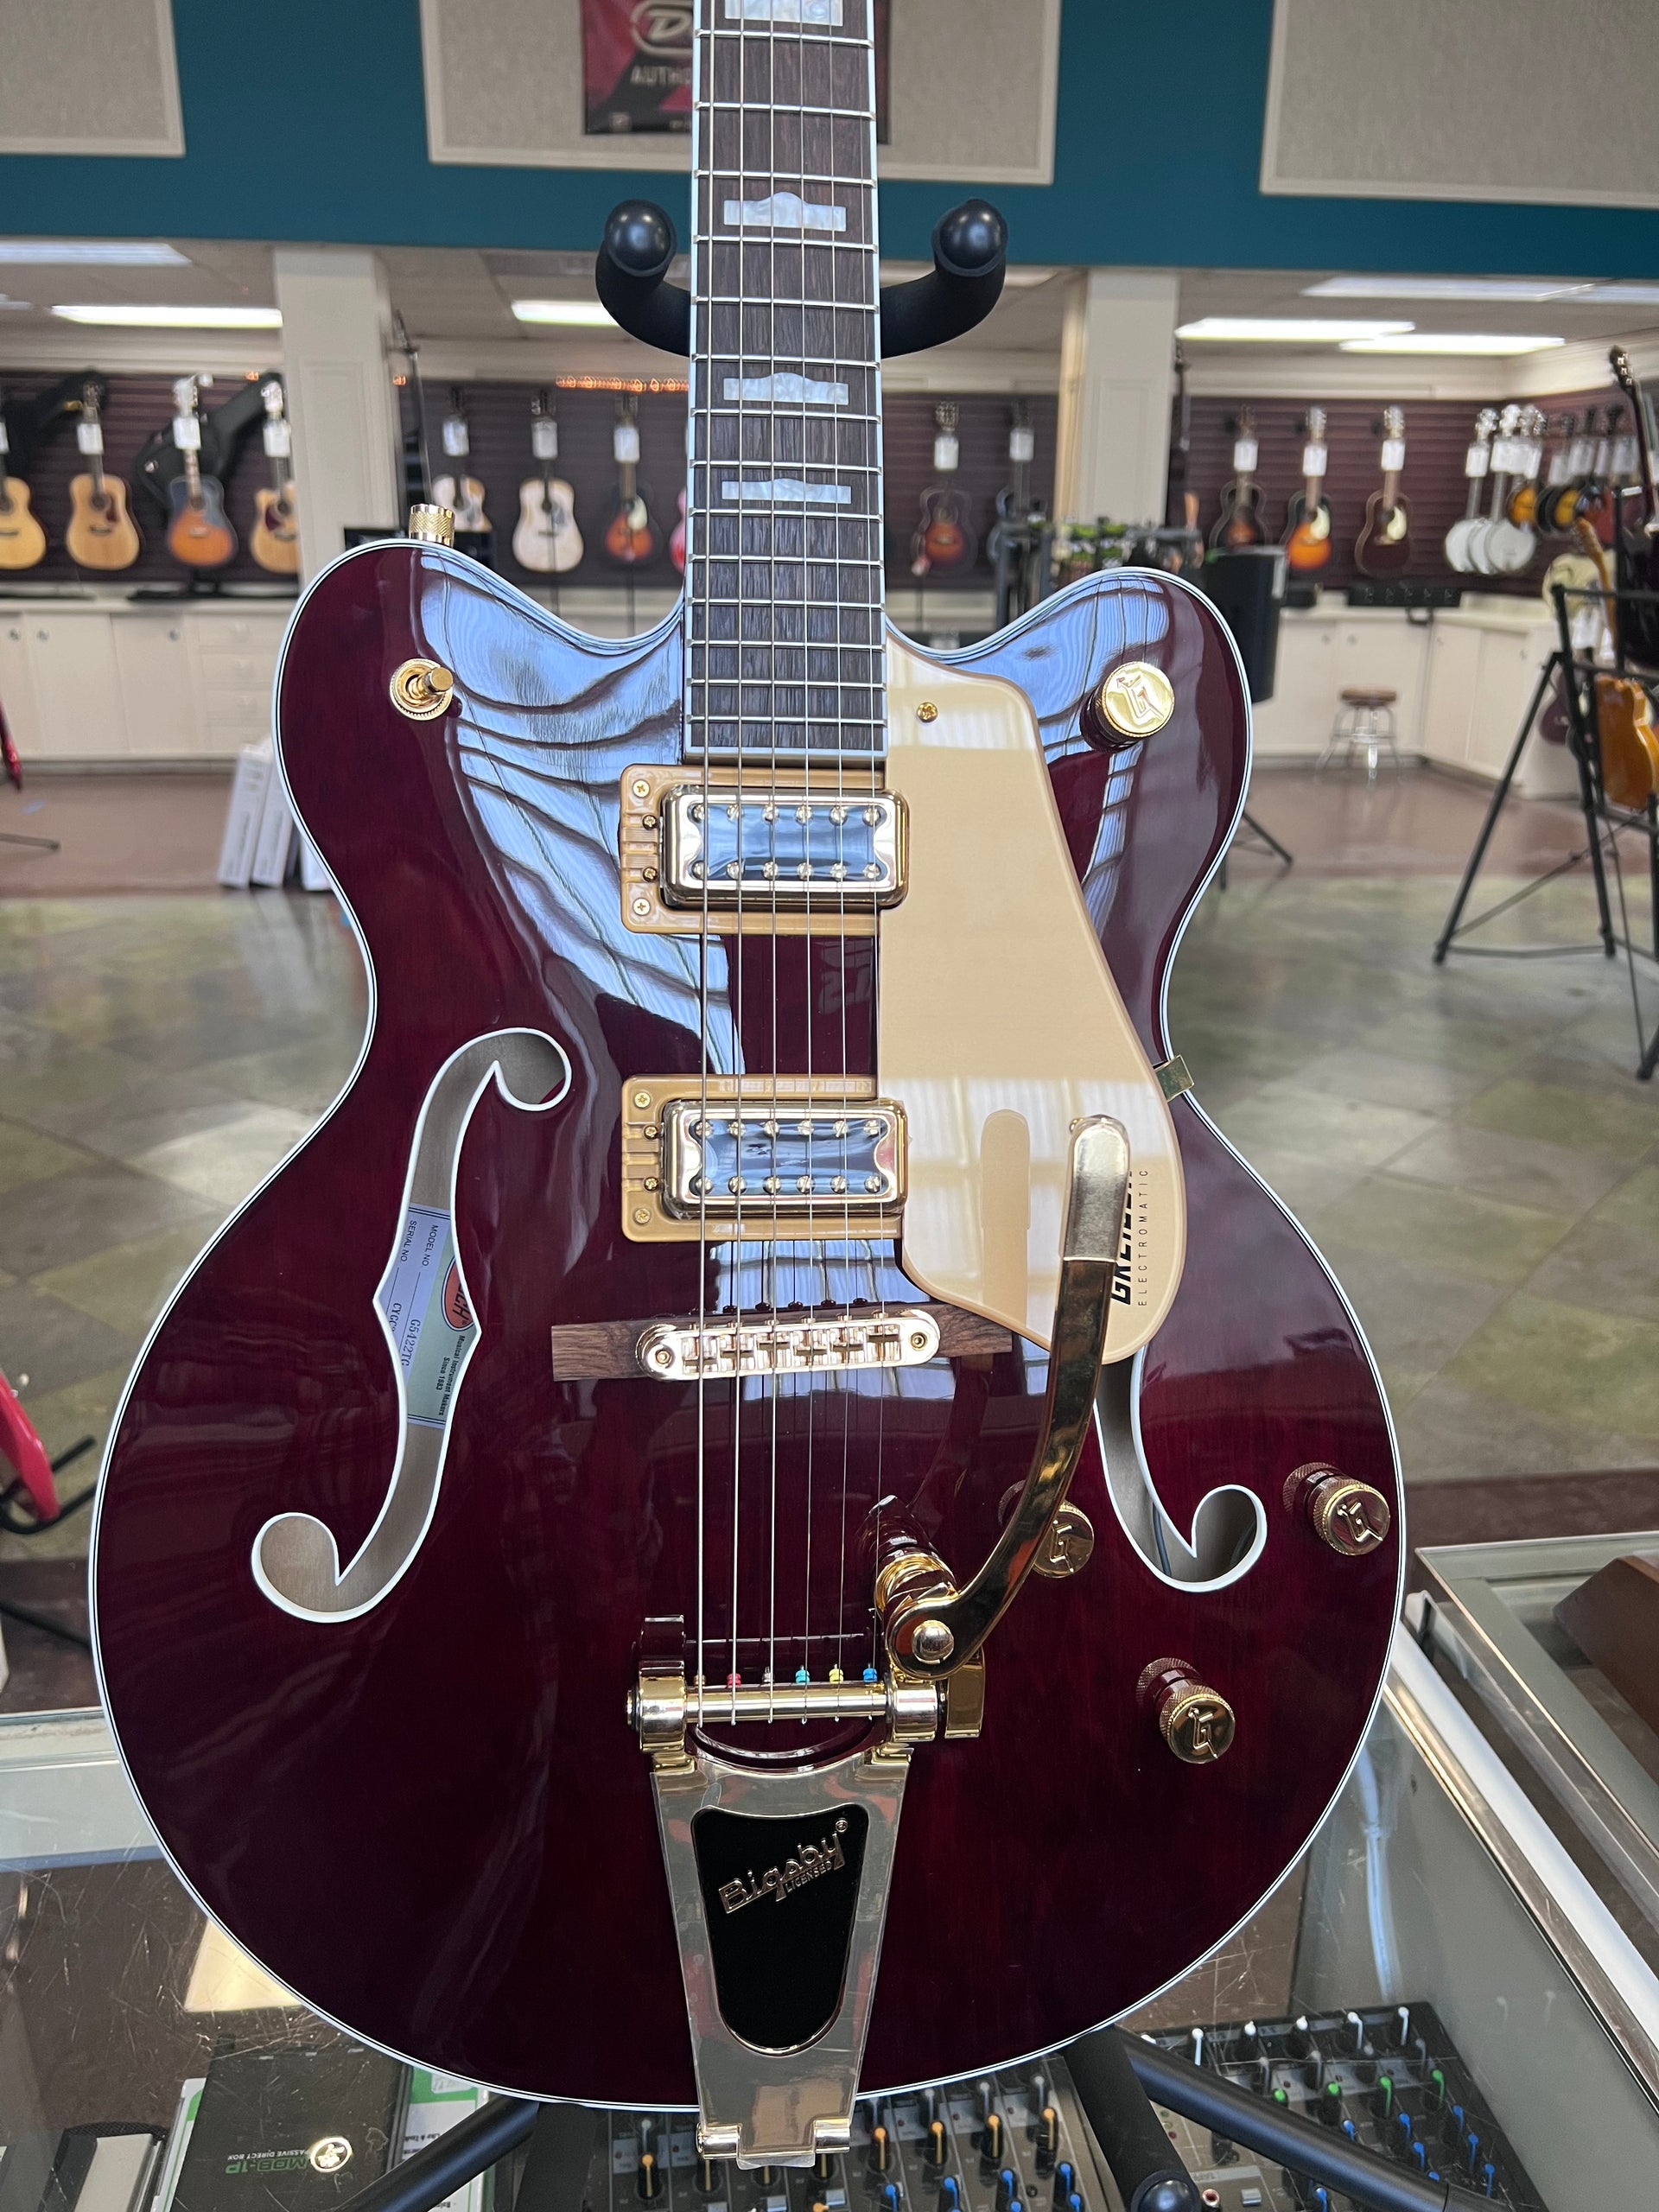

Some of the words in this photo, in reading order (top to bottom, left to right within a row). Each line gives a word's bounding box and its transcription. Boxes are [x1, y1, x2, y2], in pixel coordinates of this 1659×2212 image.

[404, 1220, 416, 1248] SERIAL
[424, 1224, 439, 1253] MODEL
[1138, 1170, 1148, 1306] ELECTROMATIC
[401, 1319, 422, 1367] G5422TG
[454, 1334, 466, 1359] Musical
[440, 1357, 450, 1374] Since
[445, 1359, 459, 1393] Instrument
[435, 1376, 446, 1391] 1883
[438, 1393, 450, 1416] Makers
[784, 1860, 833, 1893] LICENSED
[246, 2150, 276, 2160] DIRECT
